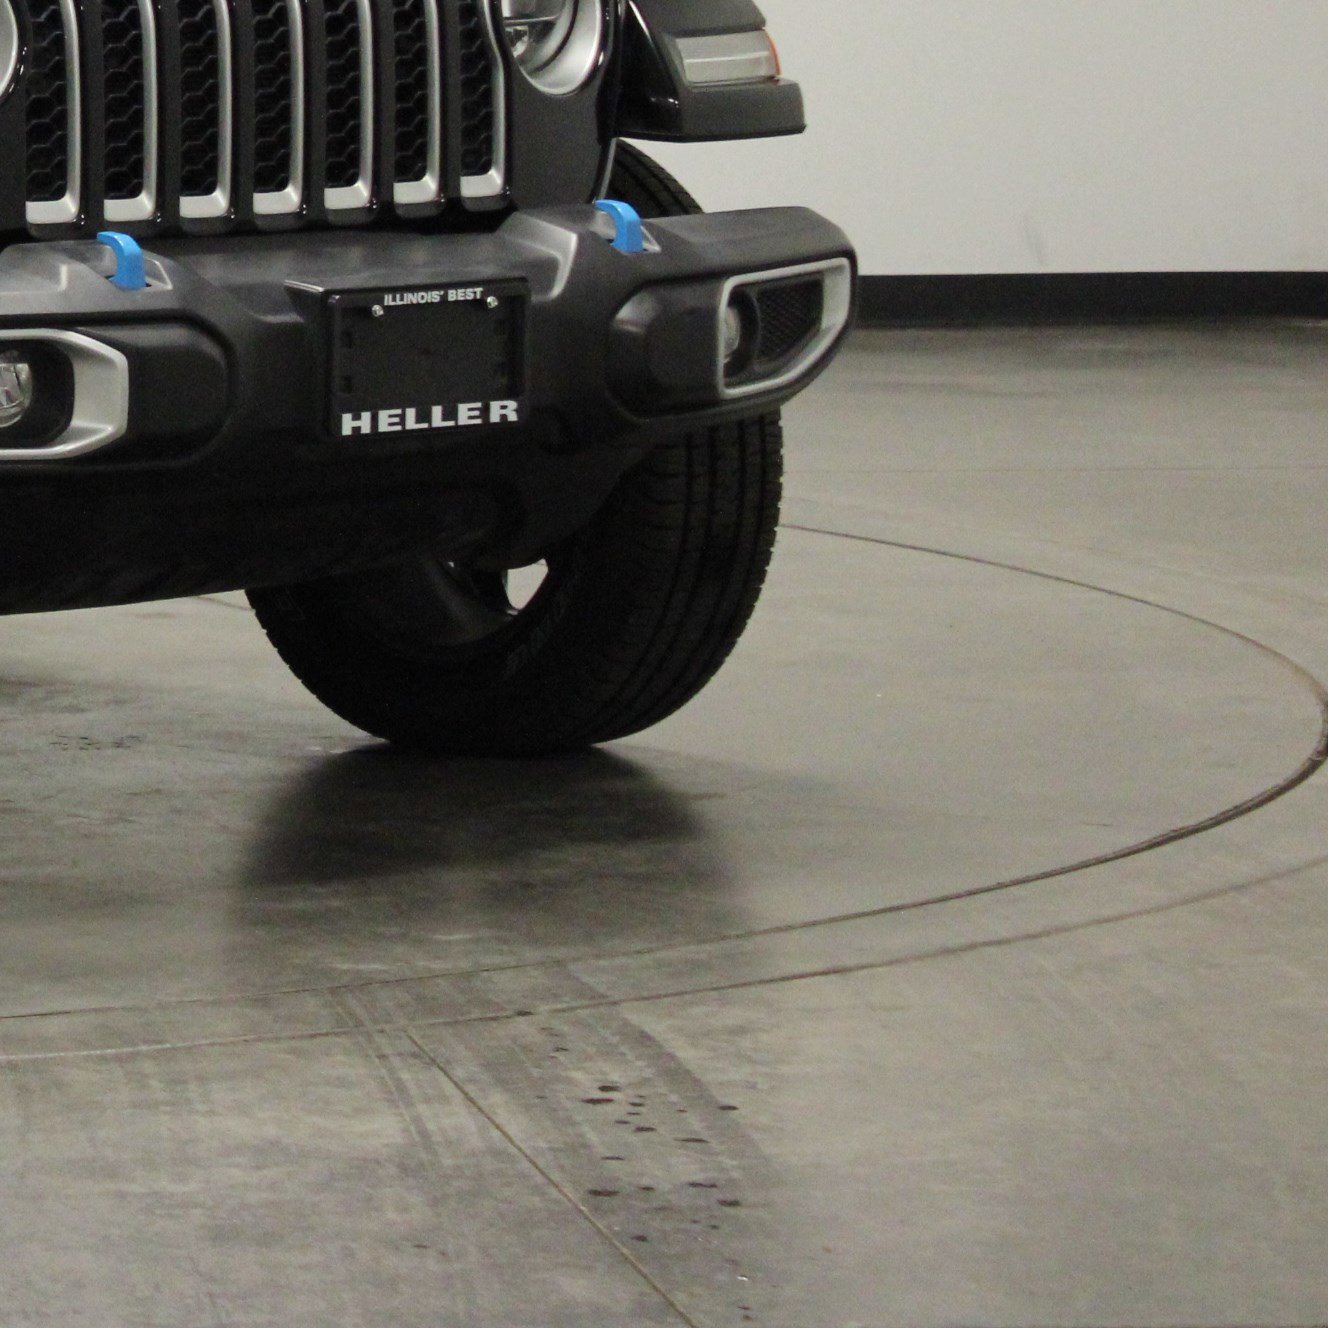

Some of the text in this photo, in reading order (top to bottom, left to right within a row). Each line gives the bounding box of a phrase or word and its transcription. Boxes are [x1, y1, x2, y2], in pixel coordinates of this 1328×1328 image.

[383, 287, 484, 306] ILLINOIS' BEST
[341, 400, 519, 436] HELLER
